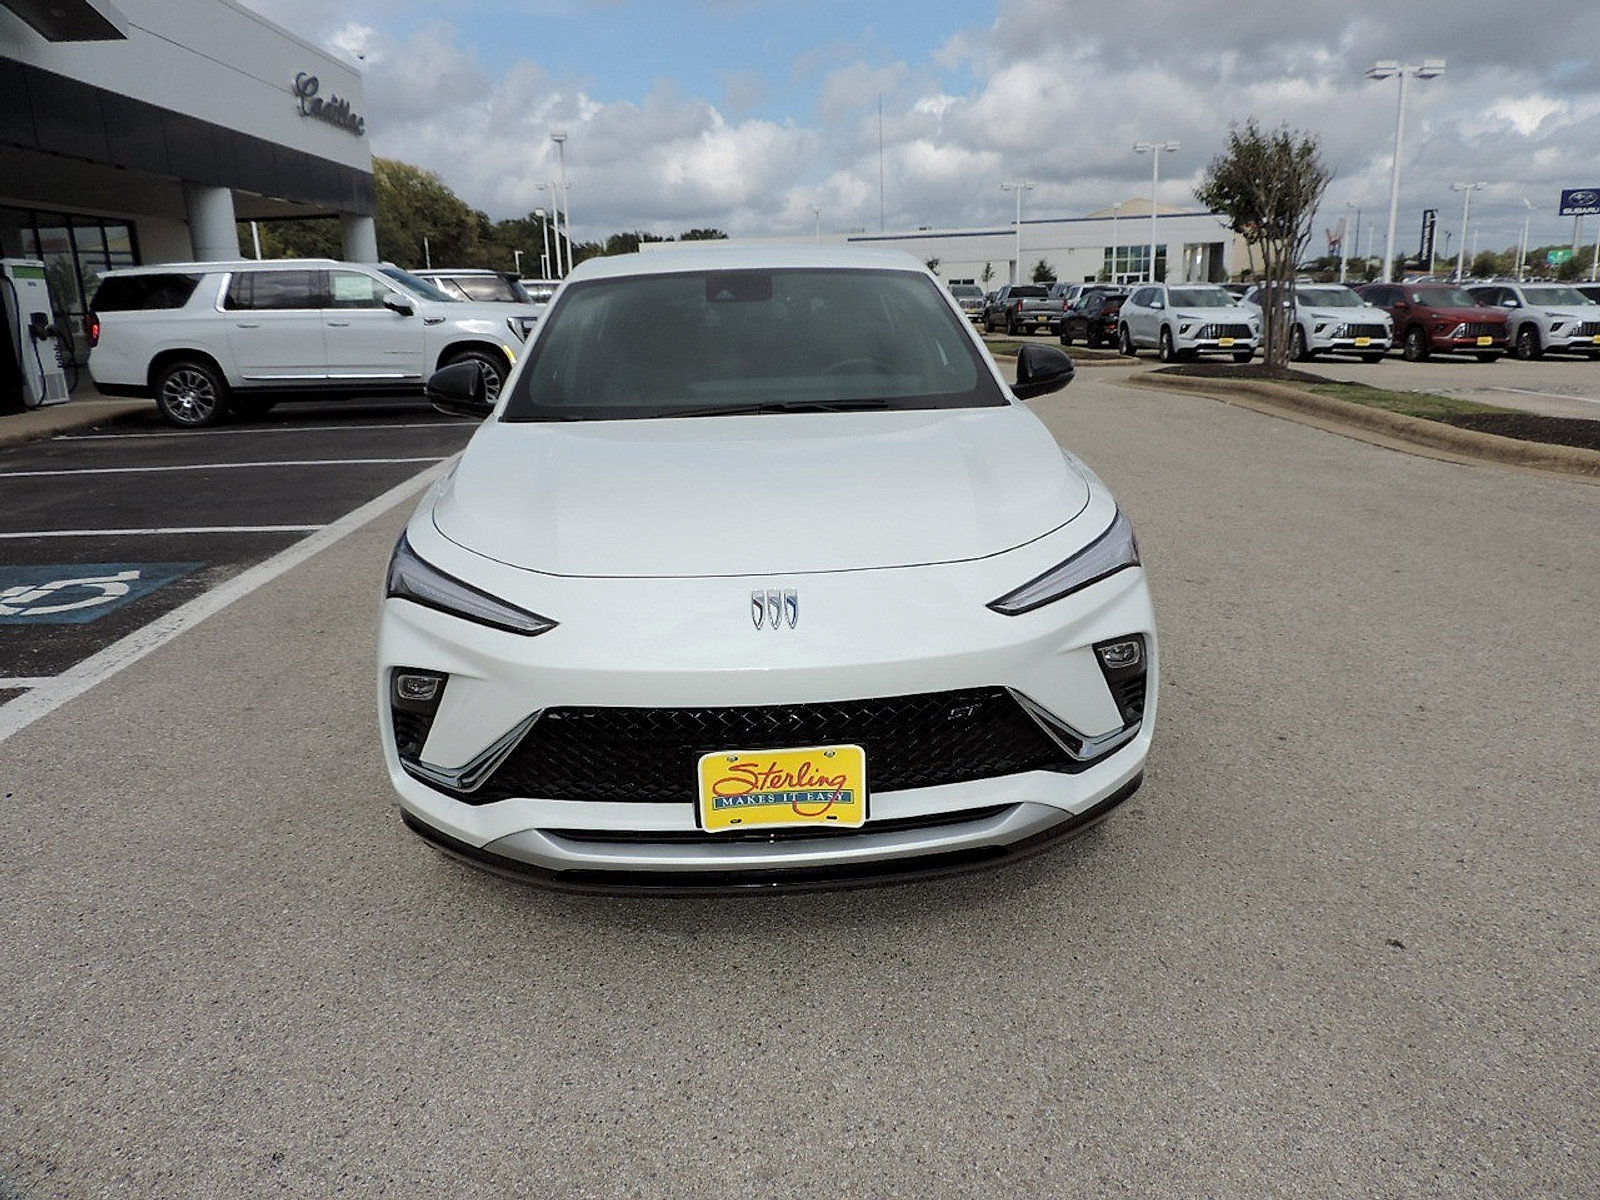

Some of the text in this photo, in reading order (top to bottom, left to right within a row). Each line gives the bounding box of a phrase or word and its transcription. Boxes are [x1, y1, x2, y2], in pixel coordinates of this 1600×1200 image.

[293, 71, 365, 136] Cadillac
[712, 761, 848, 817] Sterling
[721, 790, 843, 807] MAKES IT EASY
